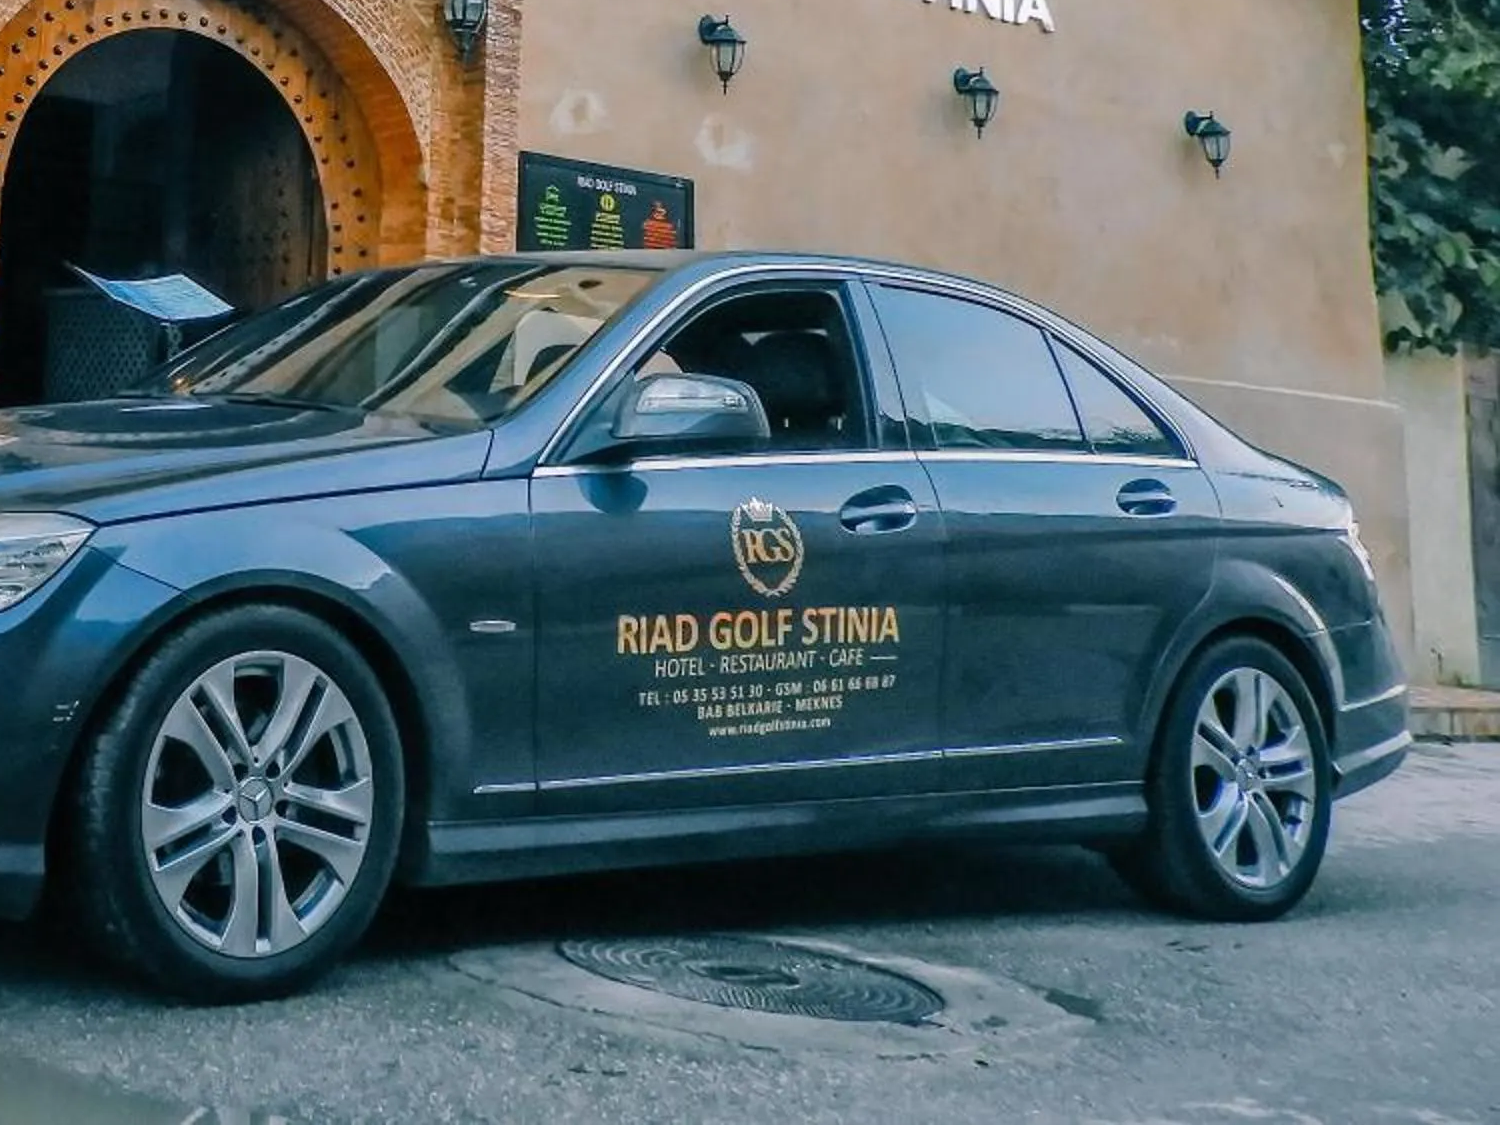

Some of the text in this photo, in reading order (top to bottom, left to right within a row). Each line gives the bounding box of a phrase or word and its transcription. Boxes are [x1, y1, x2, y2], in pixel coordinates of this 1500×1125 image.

[617, 606, 900, 654] RIAD GOLF STINIA
[655, 658, 705, 678] HOTEL
[720, 650, 816, 674] RESTAURANT
[829, 648, 864, 668] CAFE
[638, 690, 660, 706] TEL
[673, 689, 689, 704] 05
[692, 688, 707, 702] 35
[711, 686, 726, 701] 53
[730, 685, 744, 700] 51
[748, 683, 763, 698] 30
[775, 681, 802, 696] GSM
[813, 678, 827, 693] 06
[697, 704, 722, 720] BAB
[795, 695, 843, 712] MEKNES
